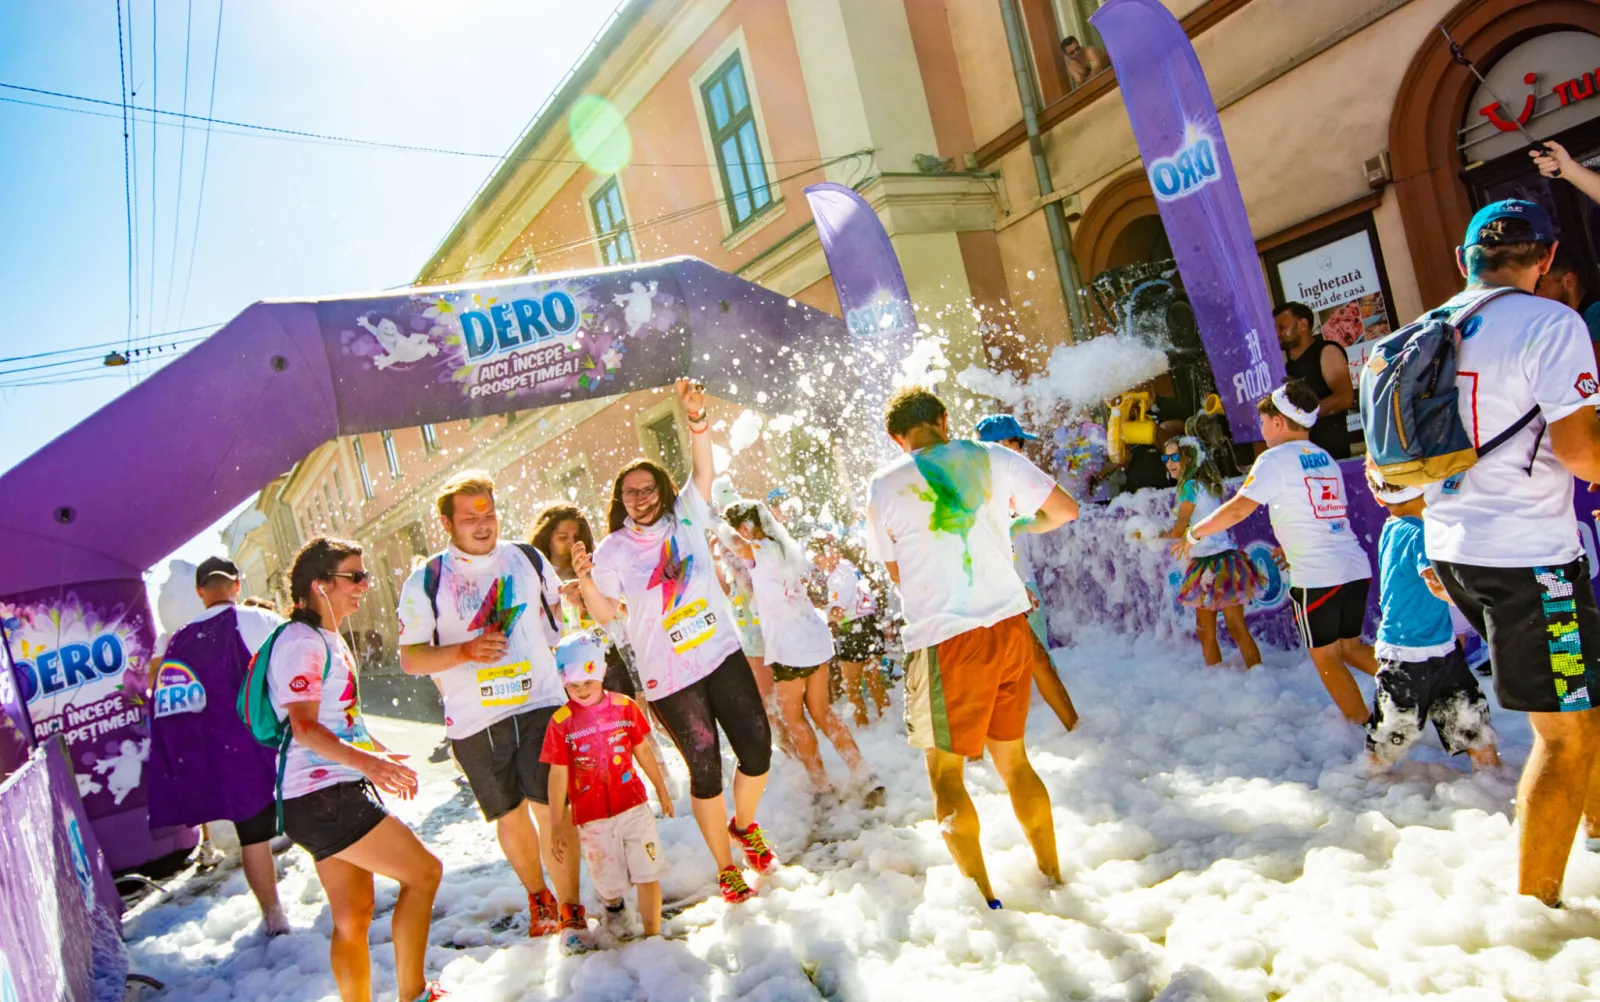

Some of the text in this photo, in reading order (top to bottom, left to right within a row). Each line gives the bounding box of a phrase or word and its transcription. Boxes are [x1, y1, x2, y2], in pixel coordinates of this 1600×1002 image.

[1330, 292, 1342, 303] de
[459, 291, 577, 359] DERO
[471, 359, 580, 399] PROSPEȚIMEA!
[480, 345, 564, 384] AICI ÎNCEPE
[1299, 452, 1330, 470] DERO
[156, 683, 204, 713] ERO
[494, 681, 521, 695] 33196
[63, 707, 140, 746] PEȚIMEA!
[65, 697, 123, 726] ÎNCEPE
